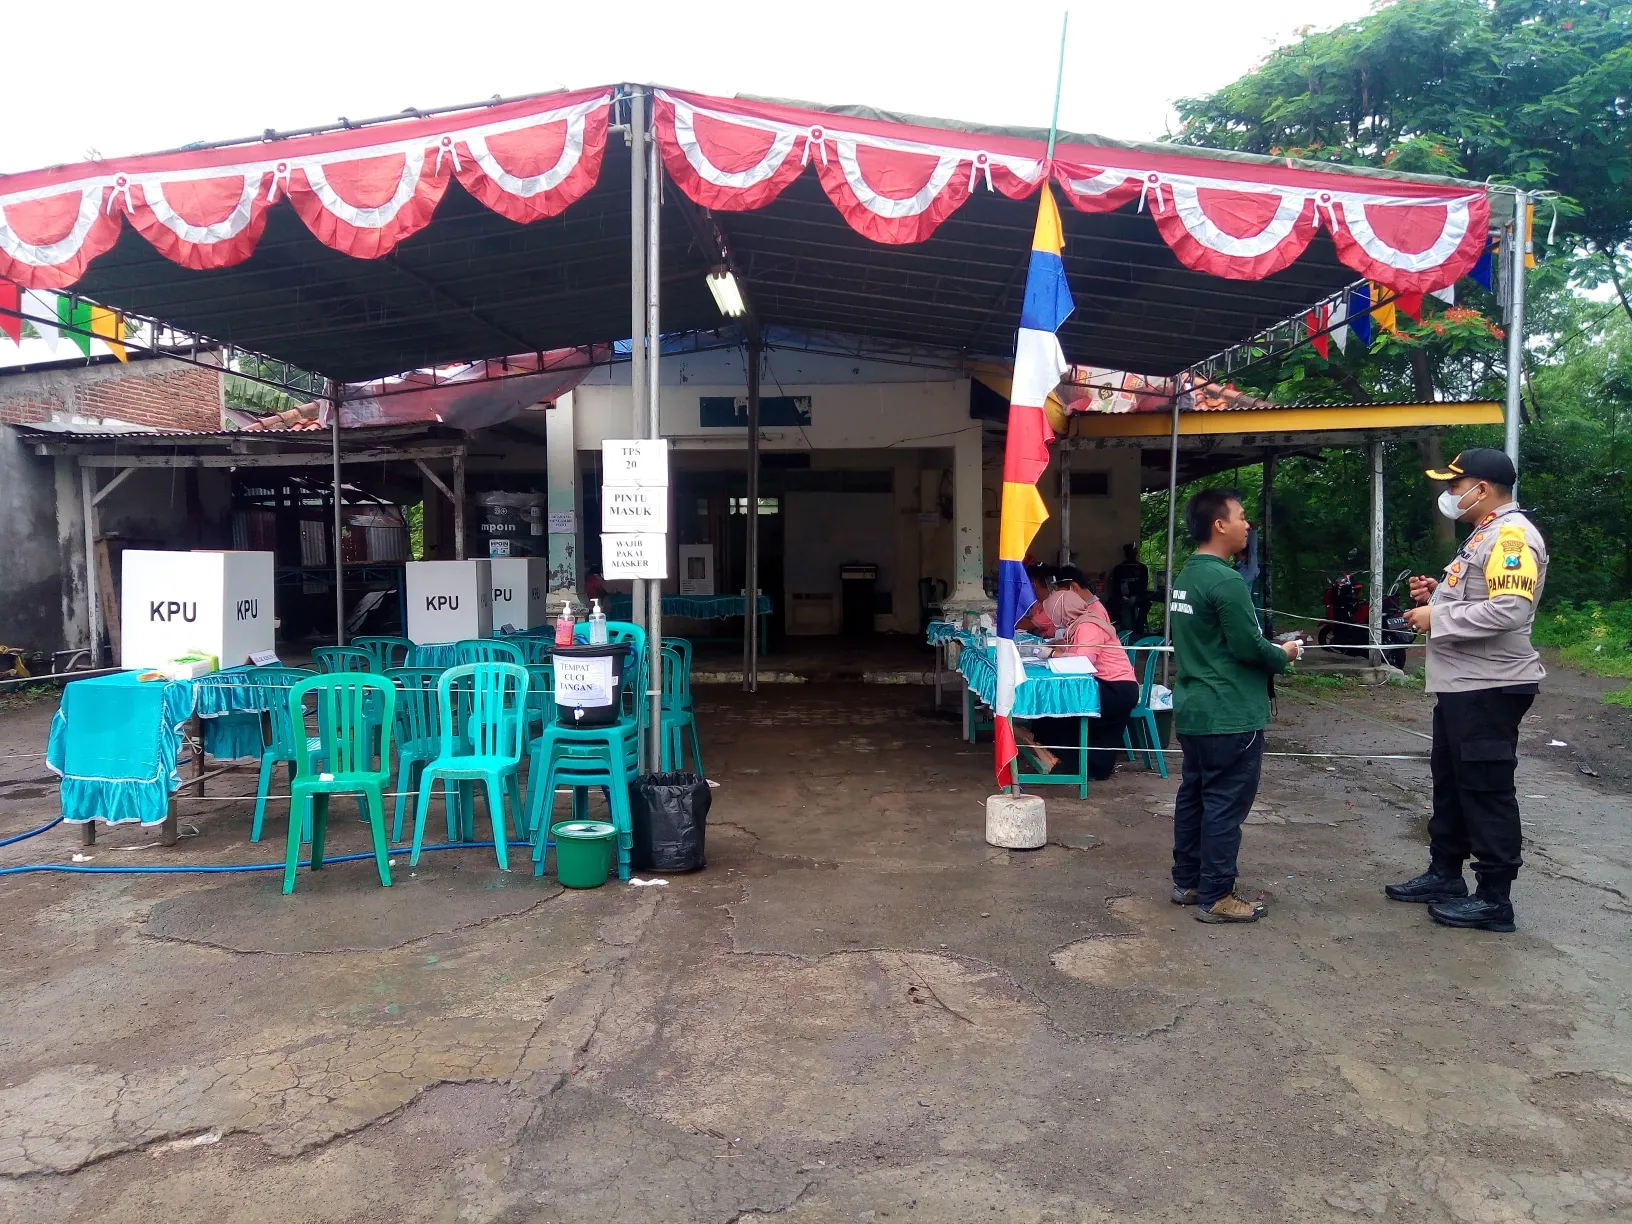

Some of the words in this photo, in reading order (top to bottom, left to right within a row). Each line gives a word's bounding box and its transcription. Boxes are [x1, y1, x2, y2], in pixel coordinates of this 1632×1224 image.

[621, 447, 641, 456] TPS
[625, 460, 637, 469] 20
[614, 493, 647, 503] PINTU
[610, 506, 652, 516] MASUK
[616, 540, 643, 548] WAJIB
[616, 550, 643, 558] PAKAI
[611, 559, 649, 568] MASKER
[492, 588, 512, 602] PU
[426, 595, 459, 611] KPU
[150, 600, 197, 622] KPU
[236, 599, 258, 621] KPU
[560, 663, 590, 671] TEMPAT
[560, 683, 593, 691] TANGAN
